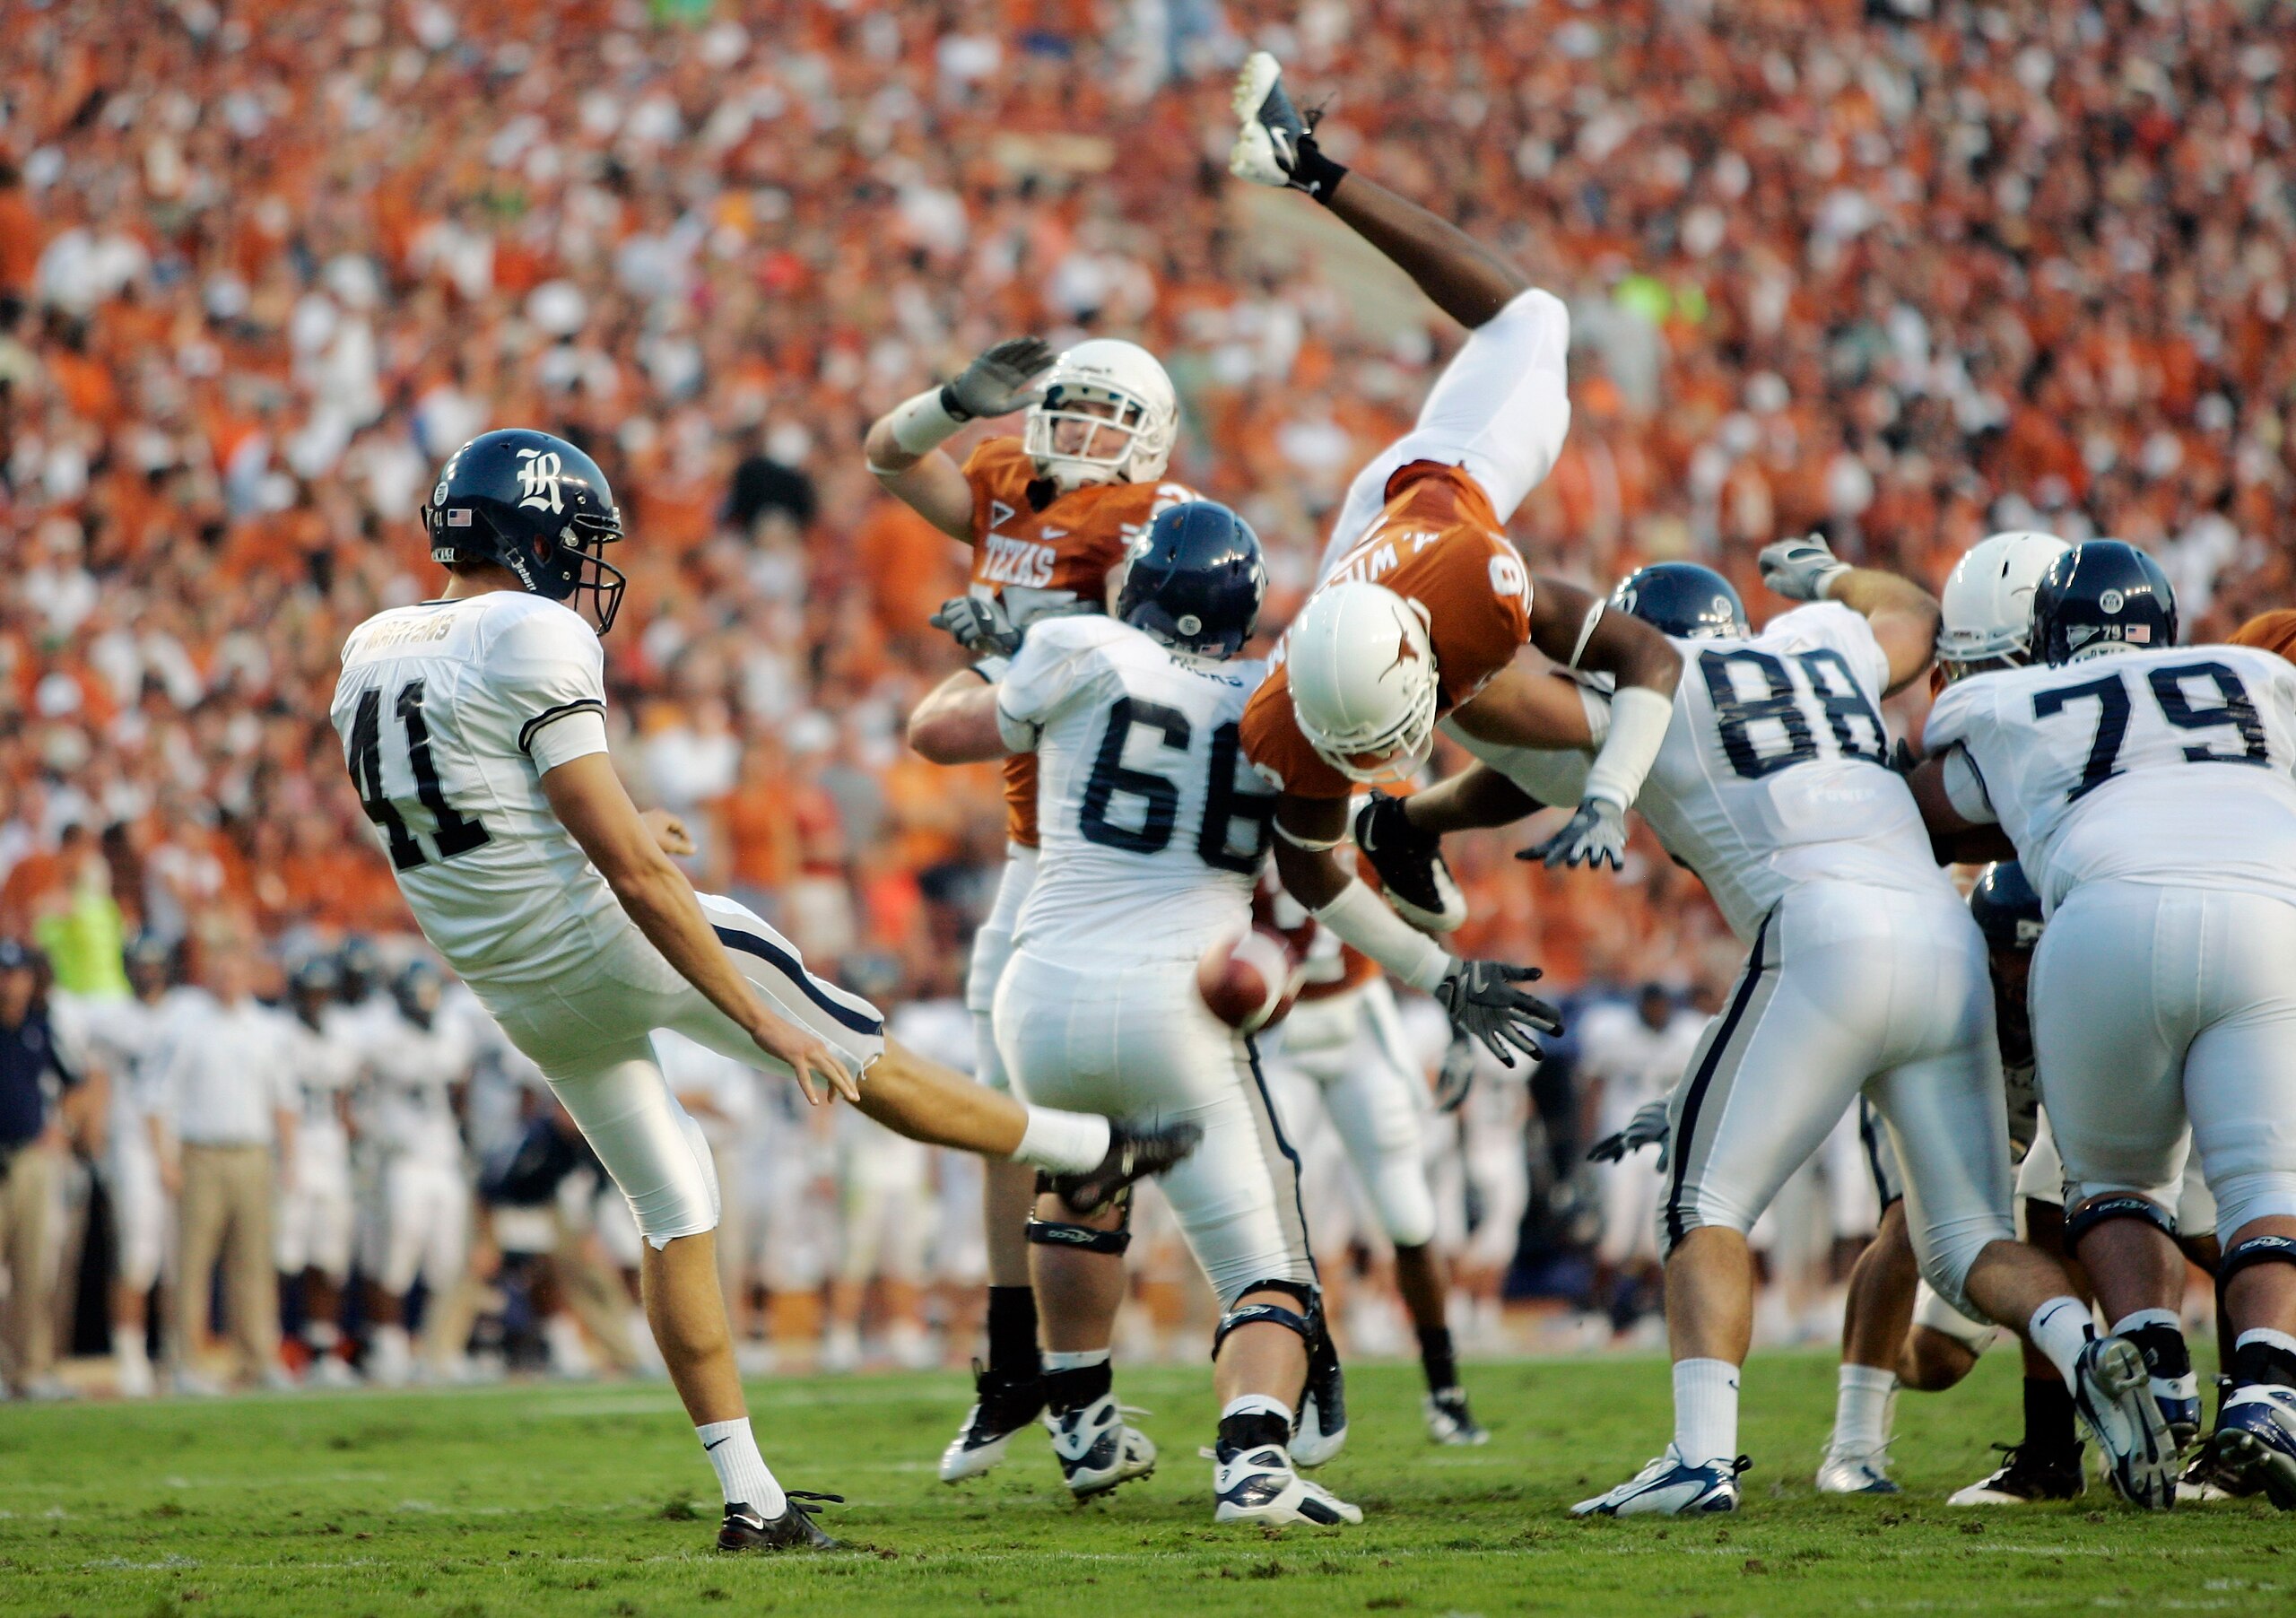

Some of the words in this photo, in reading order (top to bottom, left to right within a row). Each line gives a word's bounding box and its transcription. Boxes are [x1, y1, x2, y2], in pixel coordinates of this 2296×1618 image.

[516, 448, 565, 516] R
[433, 510, 444, 527] 41
[981, 533, 1057, 589] TEXAS
[2101, 623, 2122, 641] 79
[1698, 648, 1890, 779] 88
[2031, 662, 2273, 804] 79
[348, 679, 492, 873] 41
